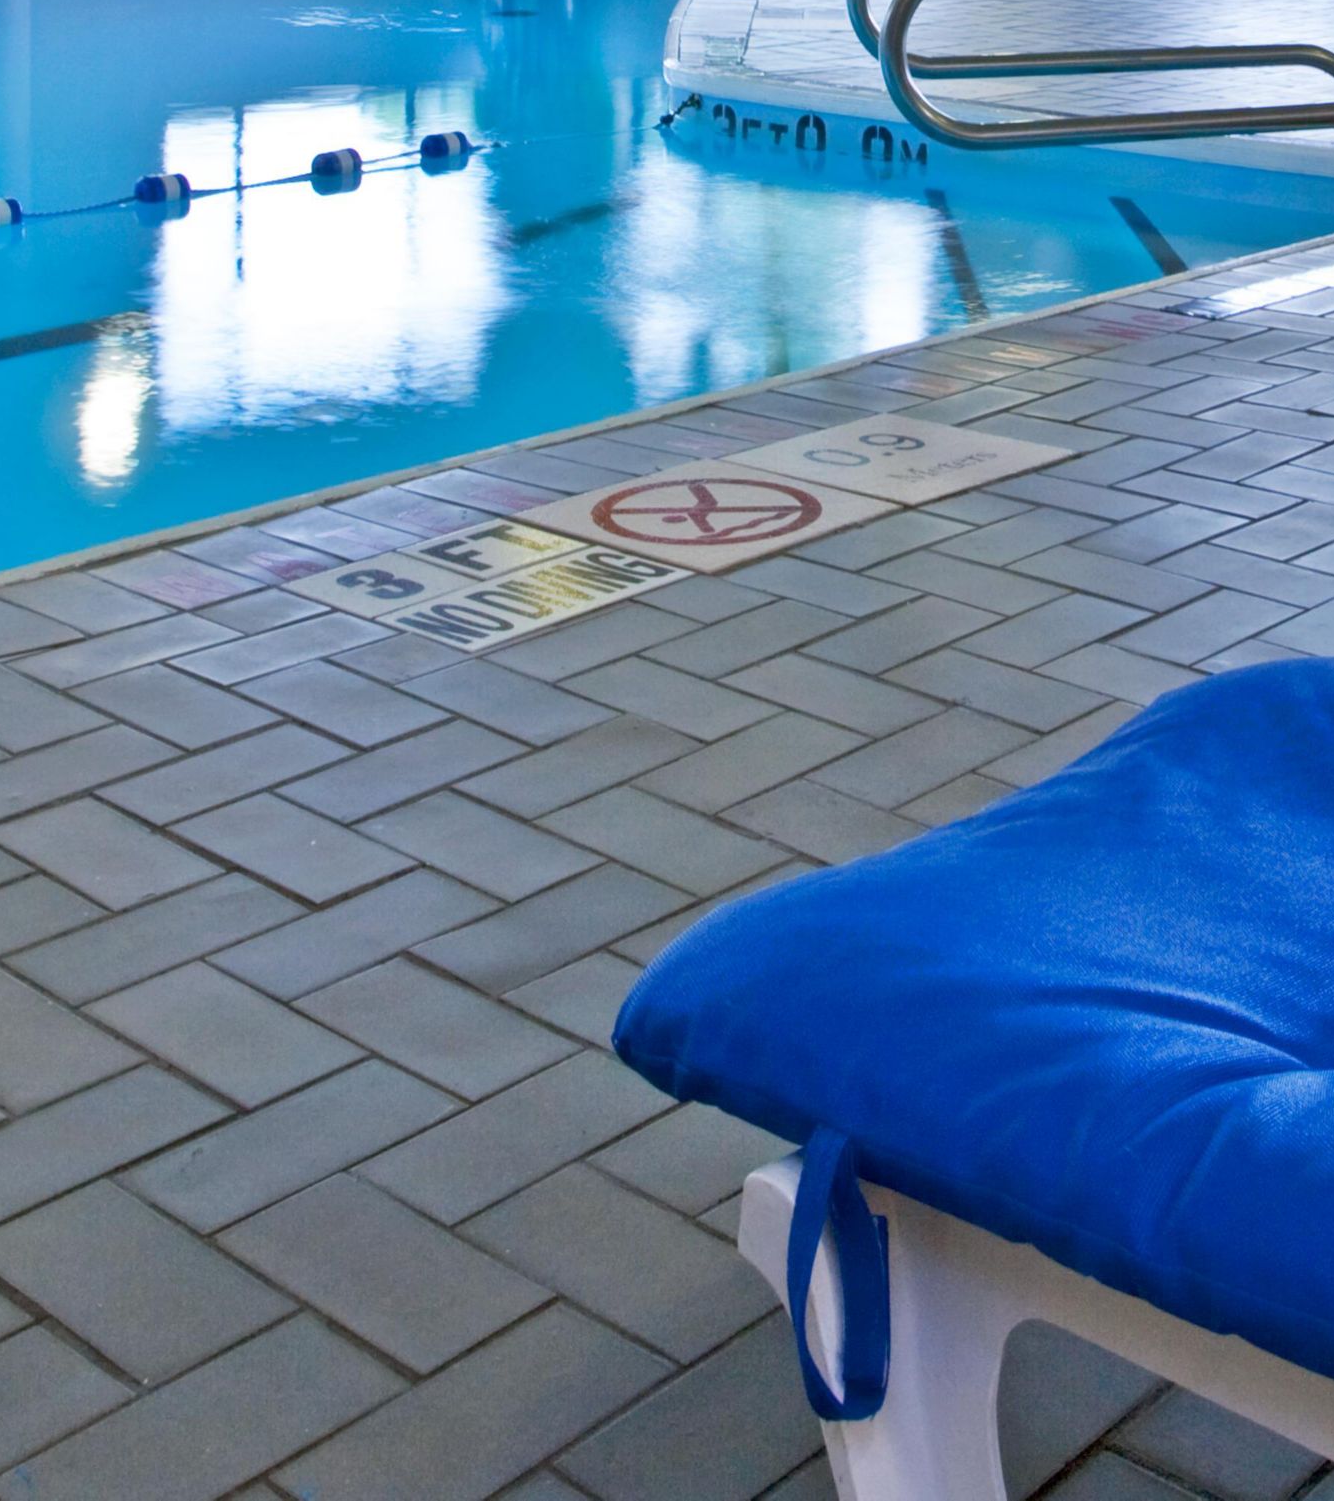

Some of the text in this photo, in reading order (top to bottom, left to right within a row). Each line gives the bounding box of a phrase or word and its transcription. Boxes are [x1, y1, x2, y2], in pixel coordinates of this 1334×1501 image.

[803, 433, 925, 466] 0.9
[336, 524, 557, 599] 3 FT
[395, 552, 676, 645] NO DIVING
